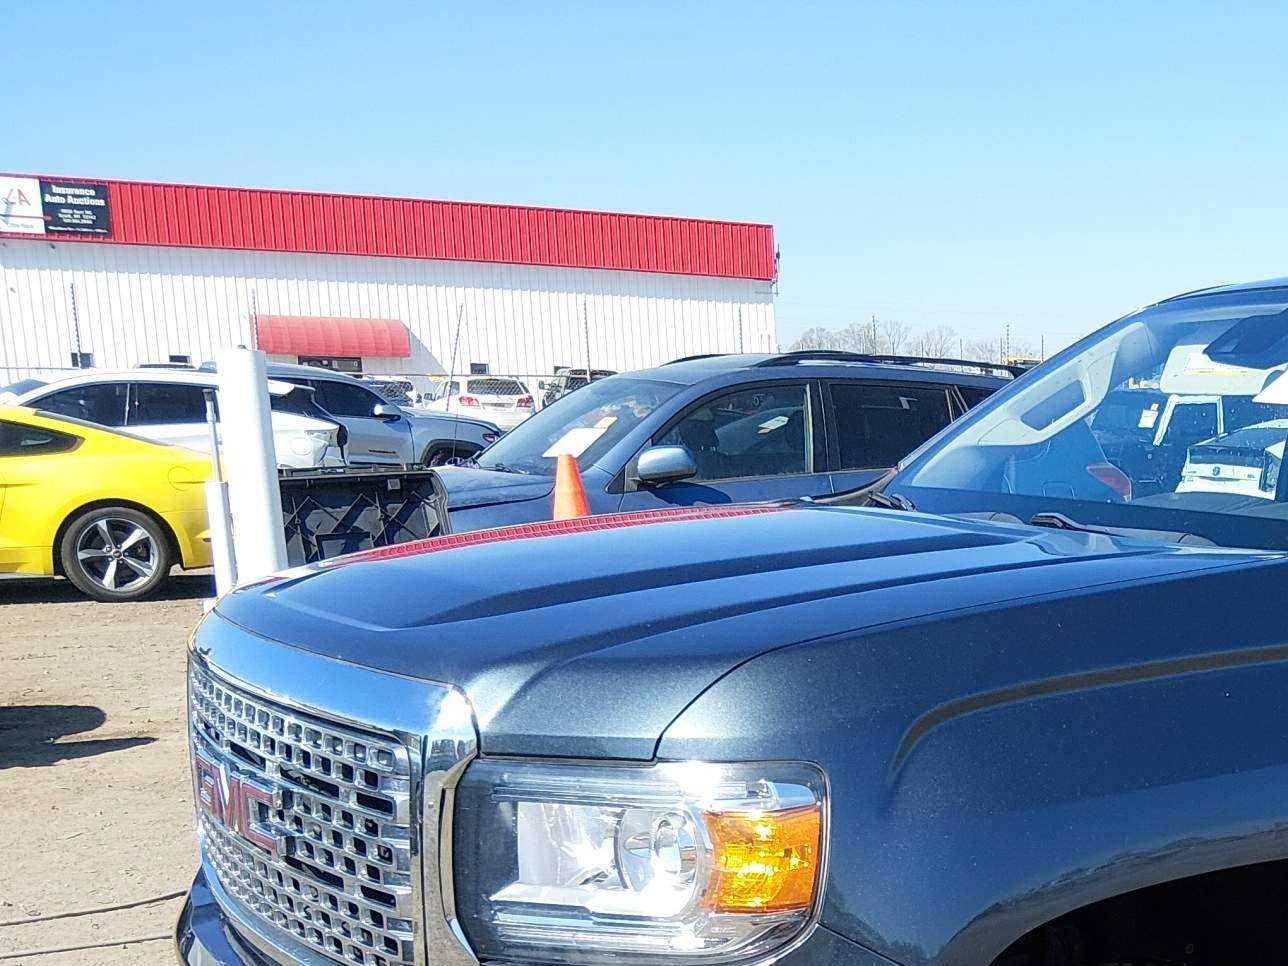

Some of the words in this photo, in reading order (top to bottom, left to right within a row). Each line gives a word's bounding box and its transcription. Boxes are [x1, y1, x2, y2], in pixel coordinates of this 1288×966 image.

[52, 185, 95, 196] Insurance
[45, 194, 65, 203] Auto
[67, 196, 105, 206] Auctions
[196, 751, 282, 855] GMC
